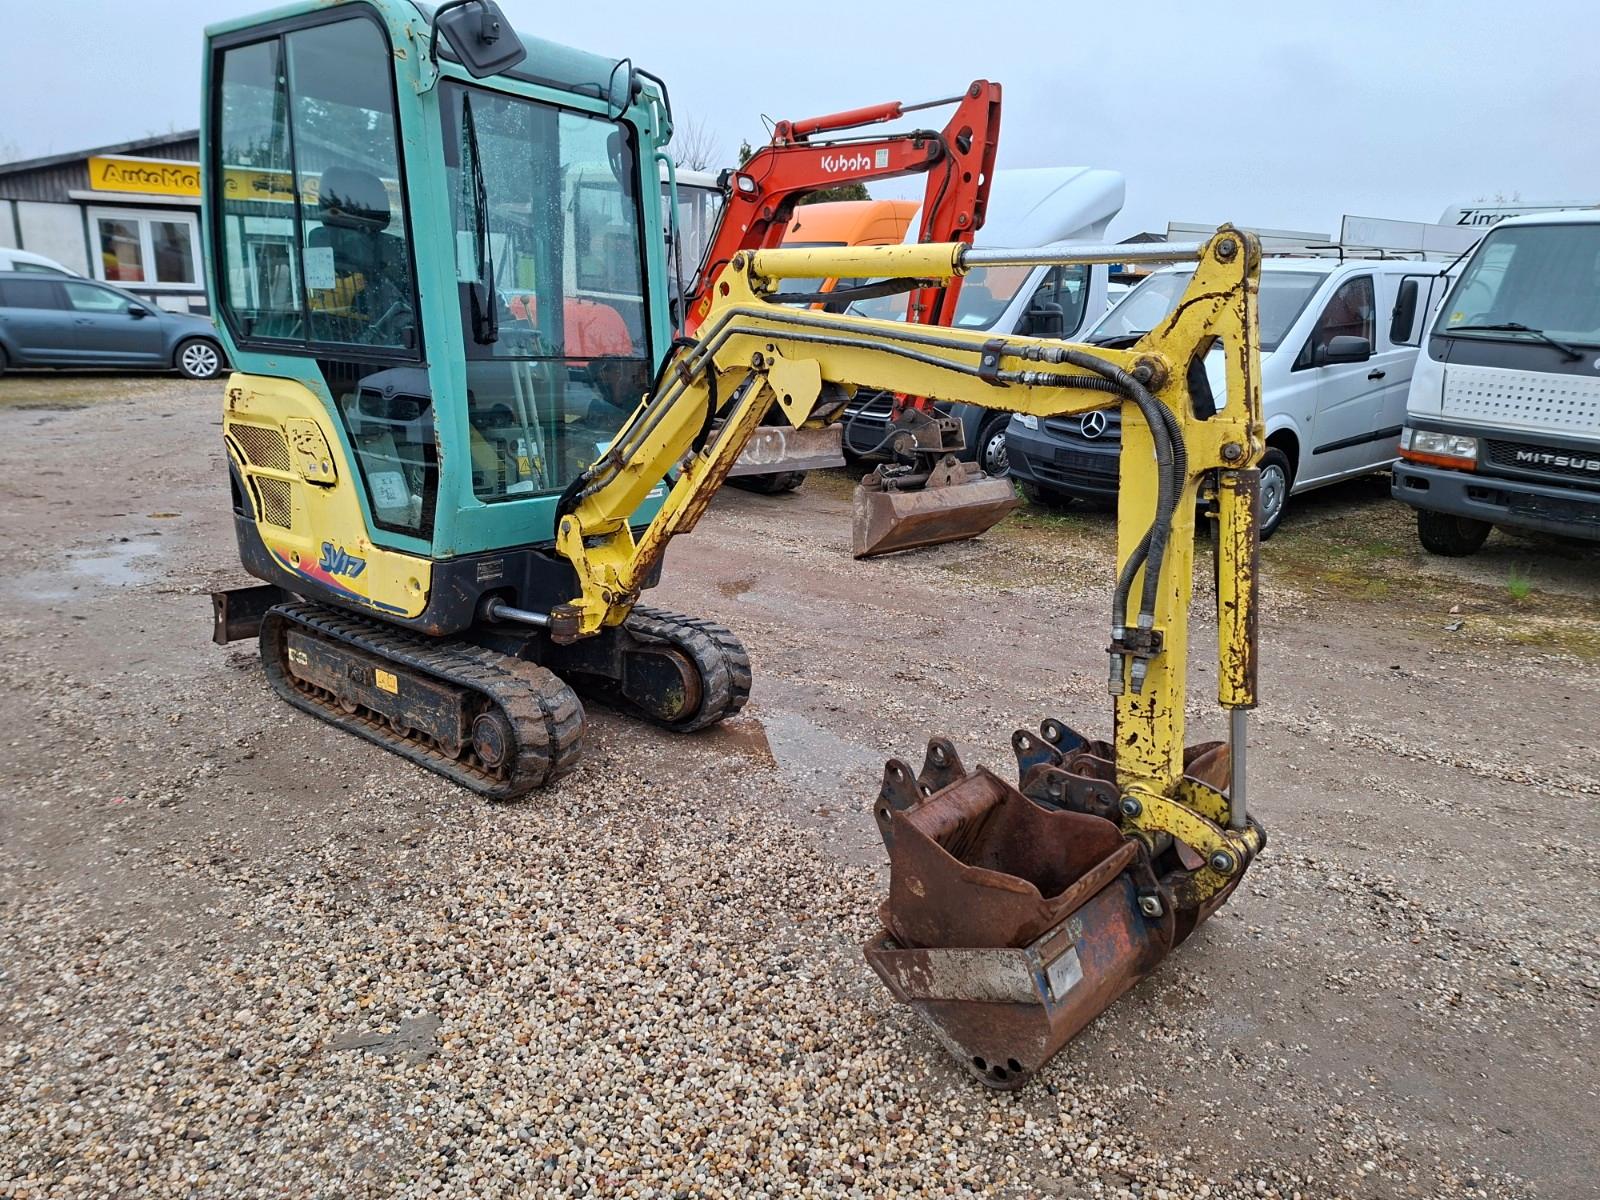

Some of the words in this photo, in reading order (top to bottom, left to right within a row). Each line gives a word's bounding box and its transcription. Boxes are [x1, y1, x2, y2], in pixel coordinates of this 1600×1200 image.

[821, 153, 871, 173] Kubota
[1516, 451, 1600, 471] MITSUB
[319, 541, 367, 579] SV17
